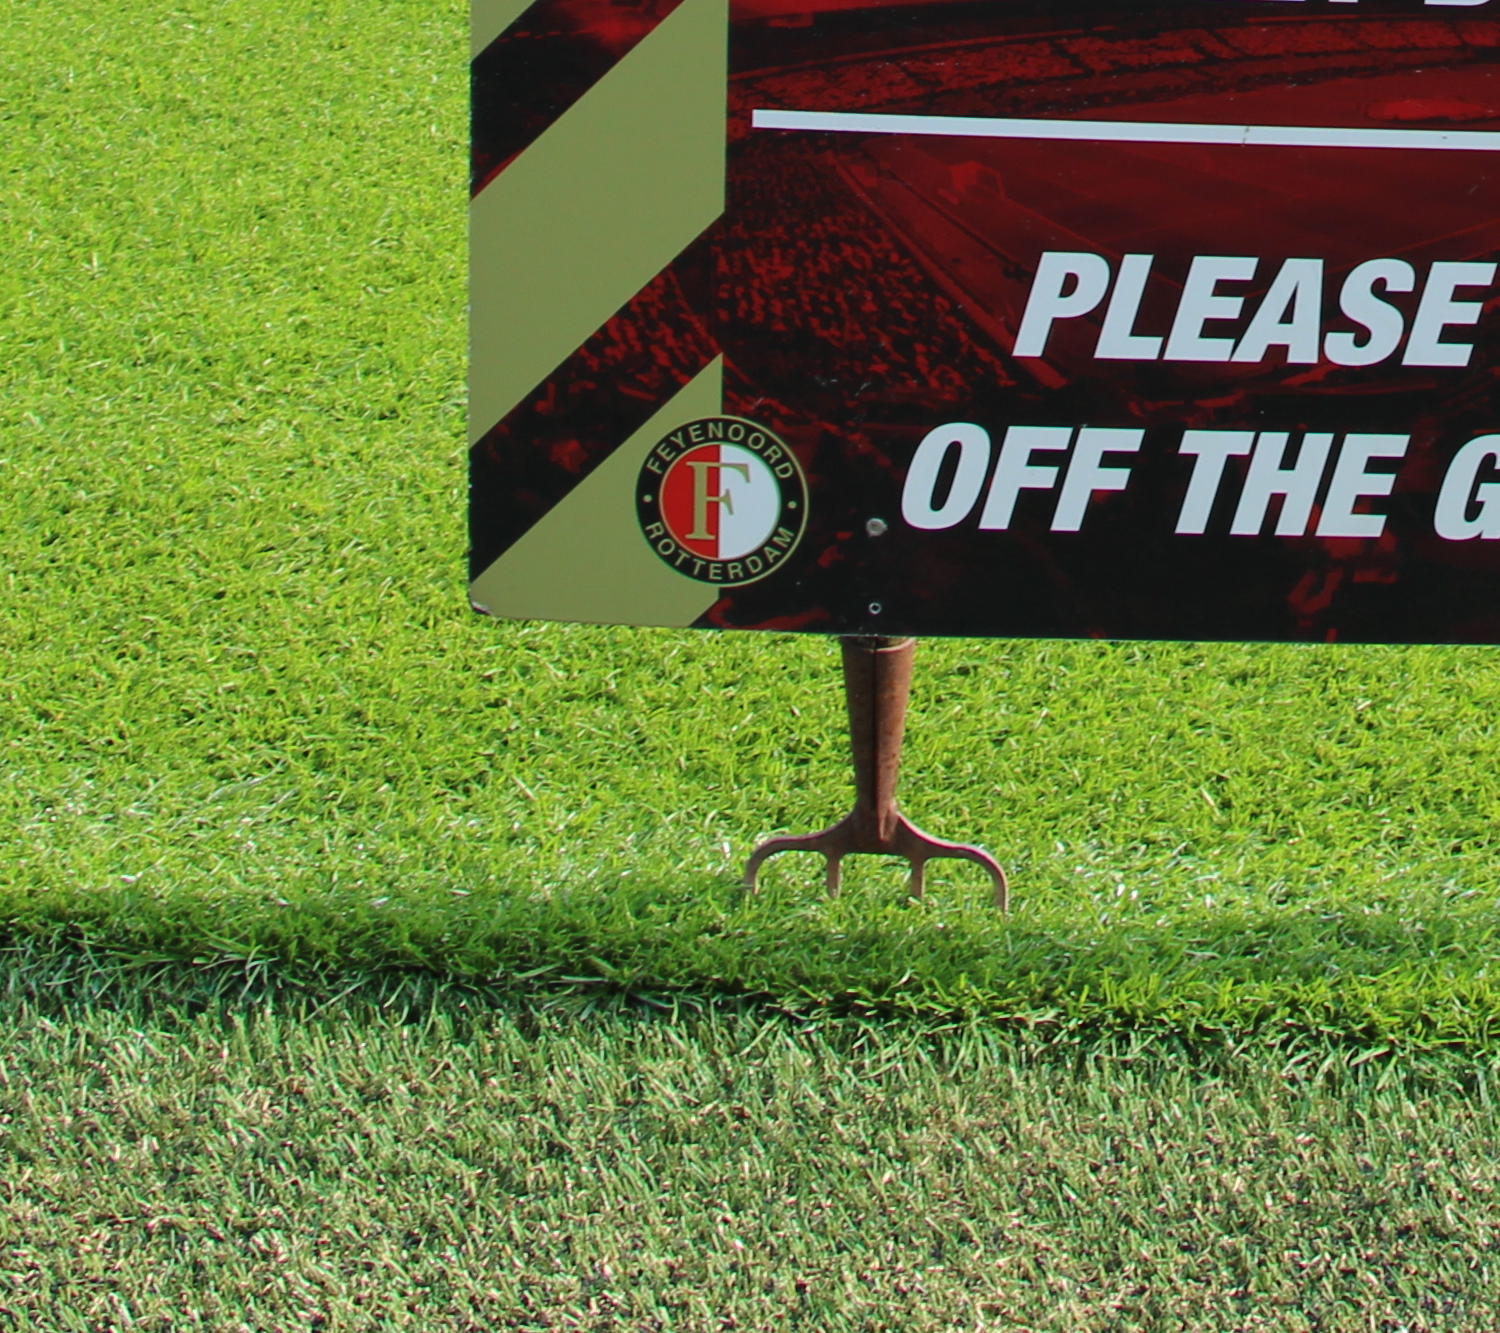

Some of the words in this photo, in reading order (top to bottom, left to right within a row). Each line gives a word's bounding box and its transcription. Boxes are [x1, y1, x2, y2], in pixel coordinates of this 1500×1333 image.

[1012, 250, 1498, 368] PLEASE
[646, 421, 794, 480] FEYENOORD
[900, 422, 1146, 531] OFF
[1173, 428, 1413, 539] THE
[685, 461, 751, 541] F
[645, 521, 795, 581] ROTTERDAM
